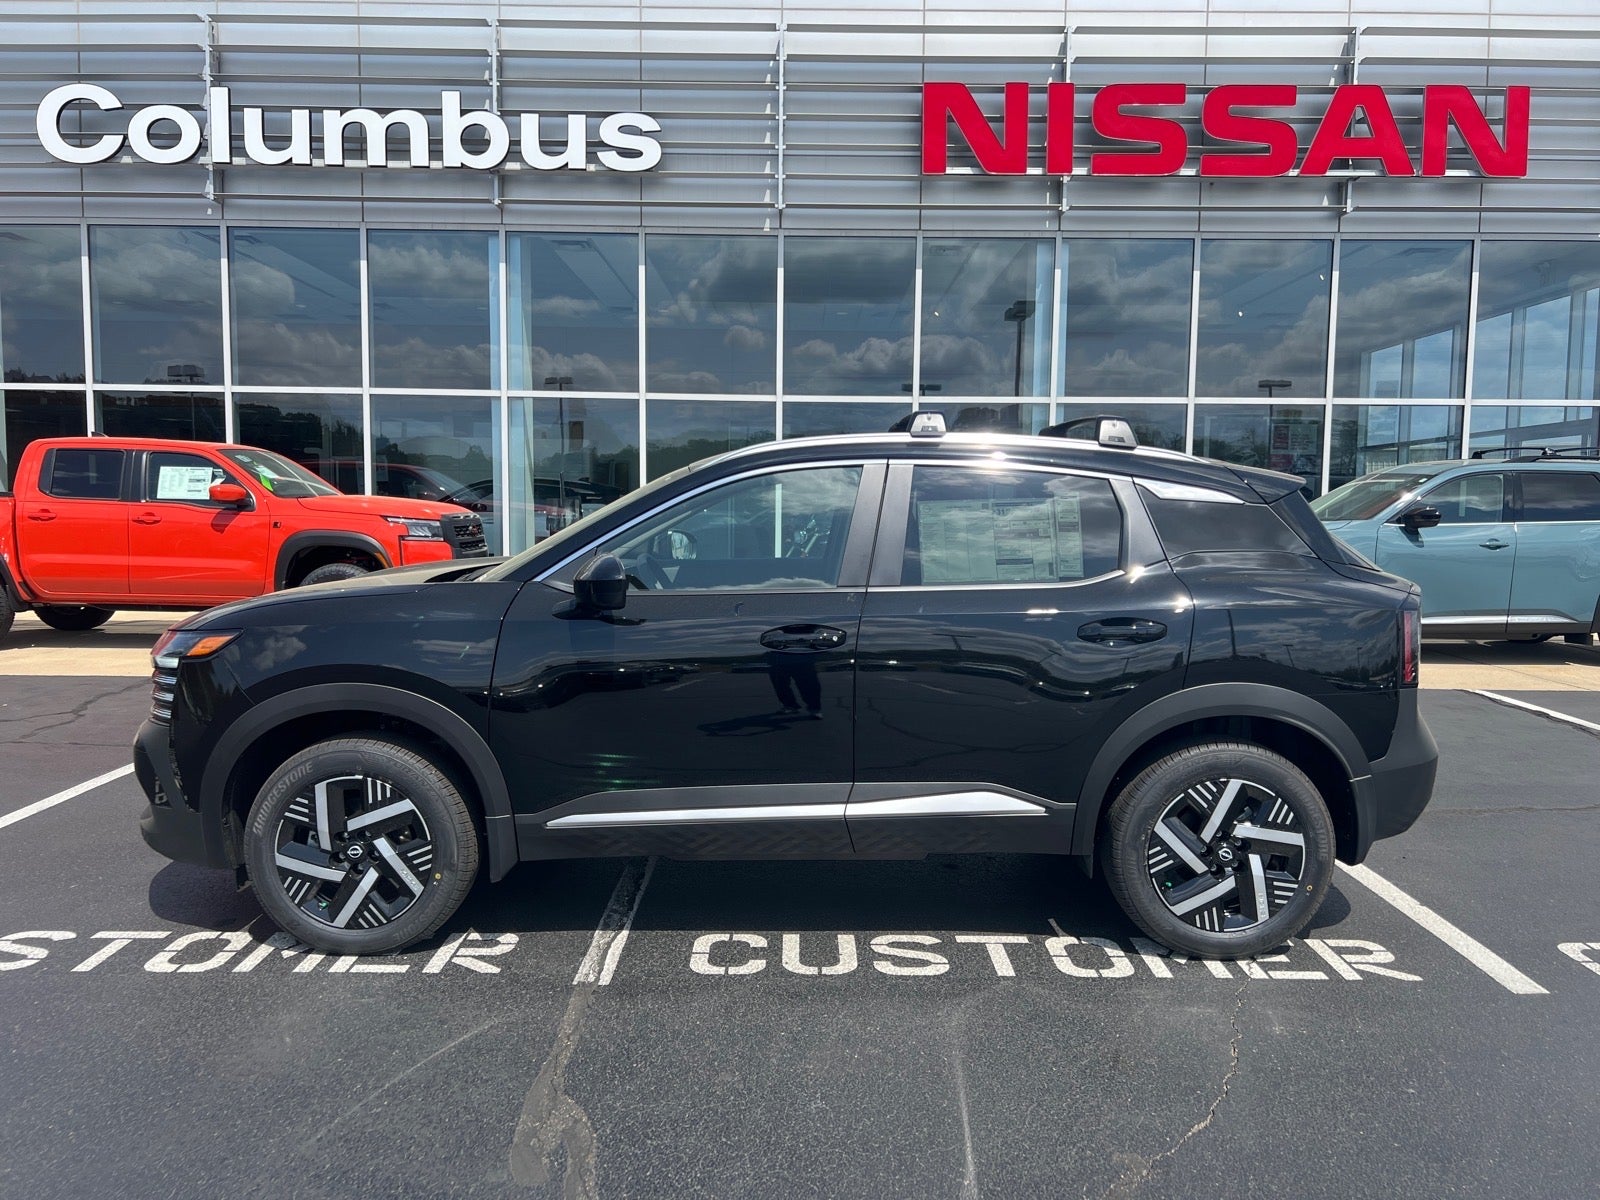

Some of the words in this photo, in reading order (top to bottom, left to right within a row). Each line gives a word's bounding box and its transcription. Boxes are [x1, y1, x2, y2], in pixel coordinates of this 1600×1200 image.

[36, 82, 663, 172] Columbus
[921, 81, 1531, 178] NISSAN
[252, 761, 313, 836] BRIDGESTONE
[689, 932, 1424, 982] CUSTOMER
